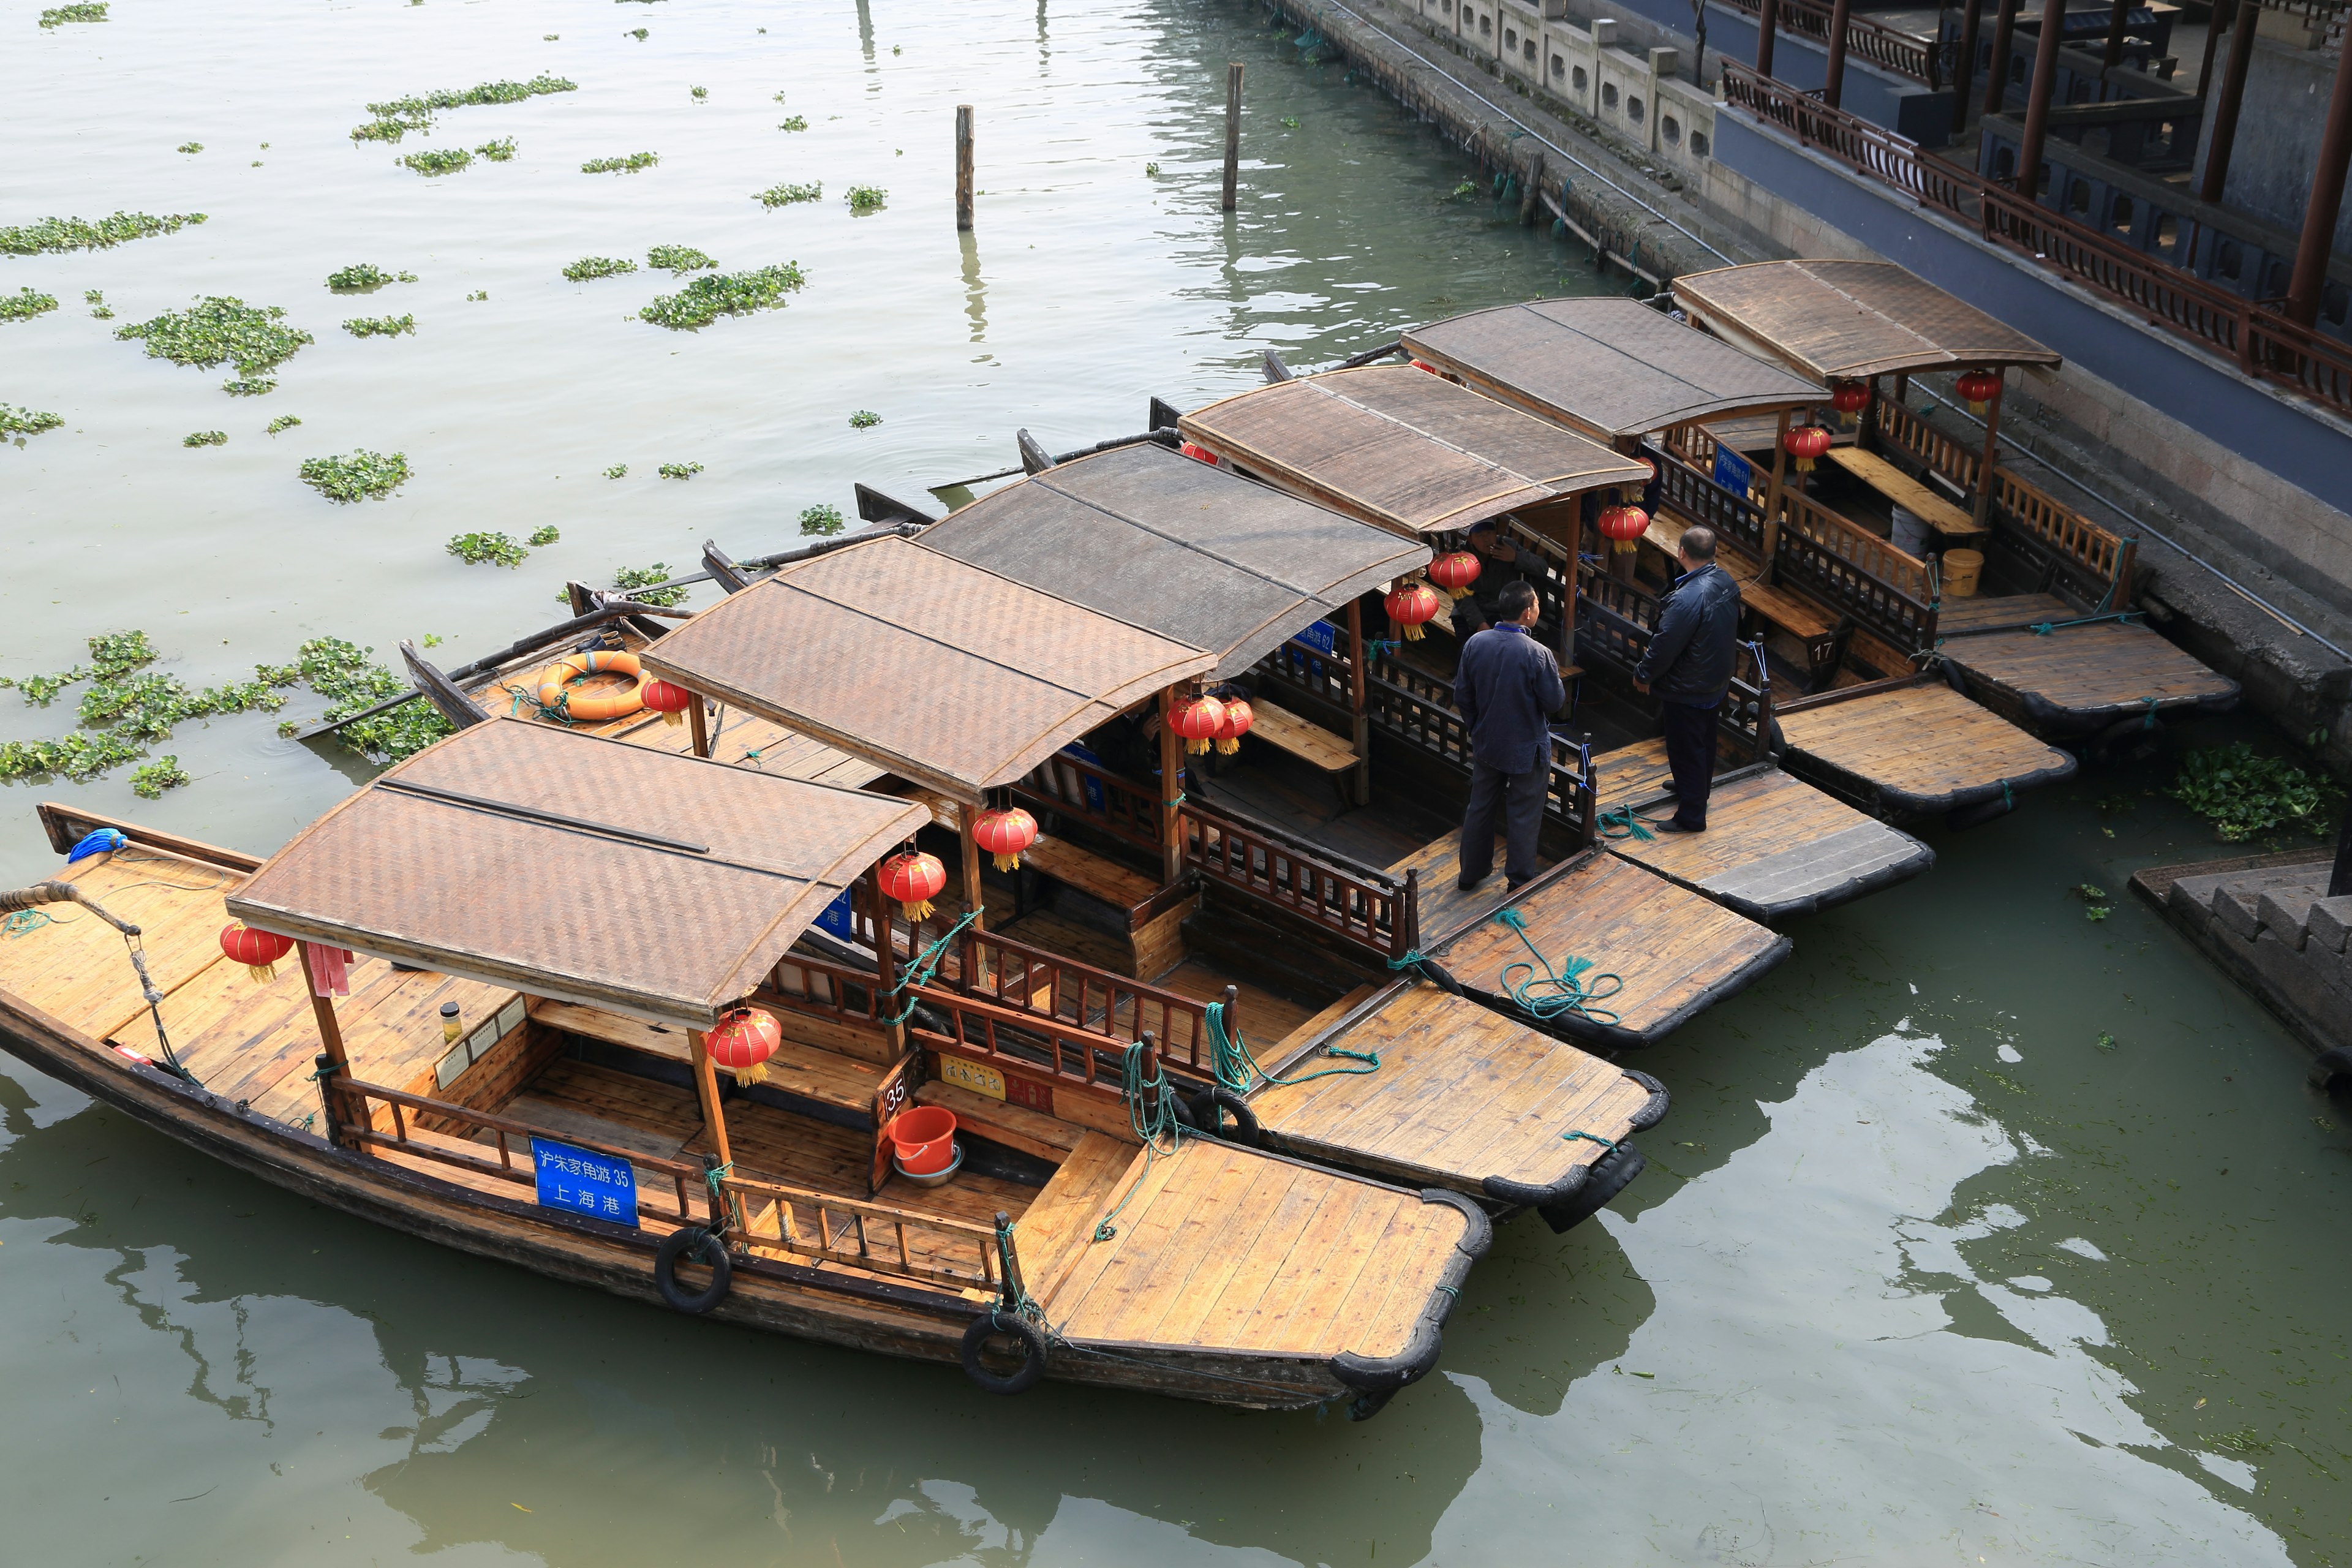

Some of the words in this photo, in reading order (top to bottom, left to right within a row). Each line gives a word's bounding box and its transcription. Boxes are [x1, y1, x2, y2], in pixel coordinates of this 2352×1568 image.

[1741, 471, 1747, 484] 61
[1322, 635, 1330, 649] 62
[1815, 641, 1833, 661] 17
[886, 1078, 904, 1112] 35
[540, 1150, 611, 1183] 沪朱家角游
[614, 1169, 628, 1188] 35
[554, 1184, 620, 1215] 上海港
